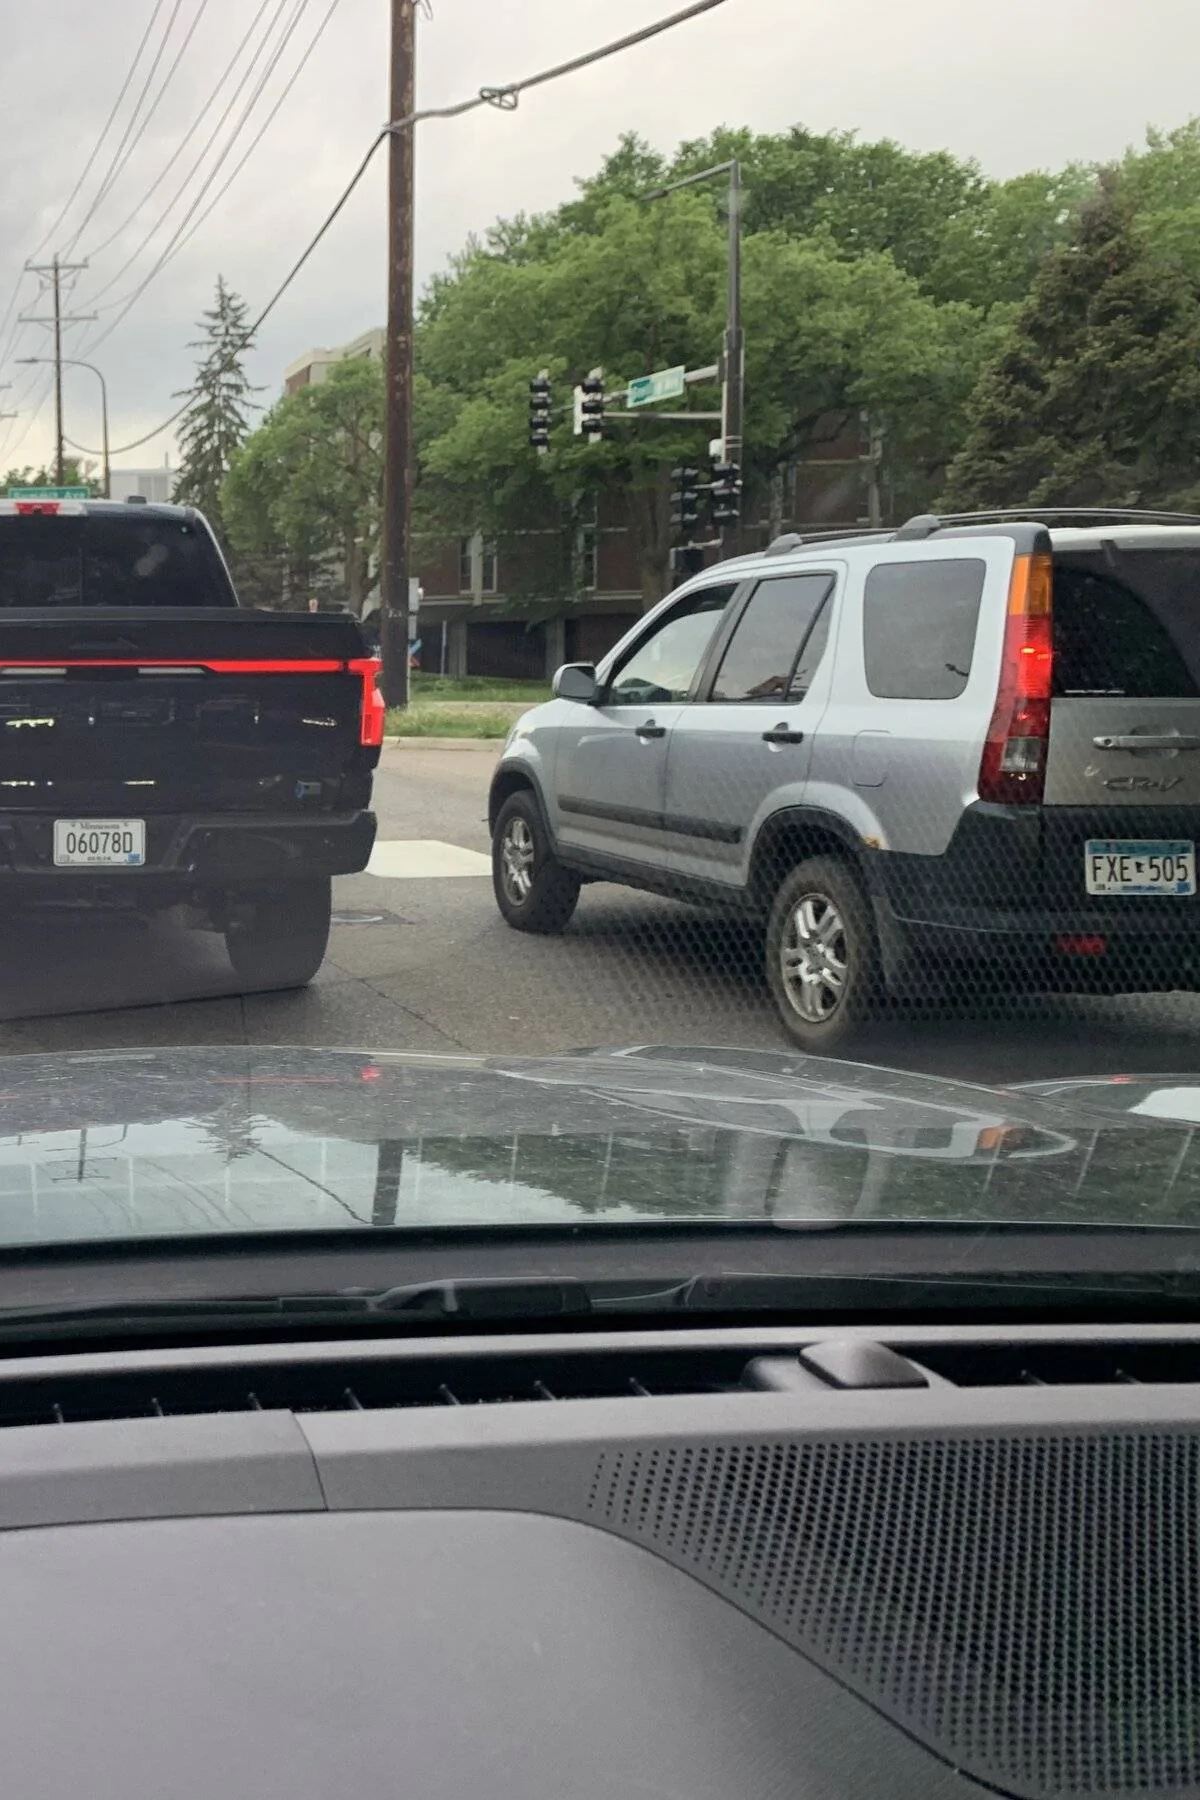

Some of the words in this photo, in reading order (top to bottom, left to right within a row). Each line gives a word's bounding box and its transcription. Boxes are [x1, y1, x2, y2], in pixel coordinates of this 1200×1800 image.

[66, 832, 133, 854] 06078D
[1092, 856, 1132, 882] FXE
[1149, 856, 1188, 882] 505
